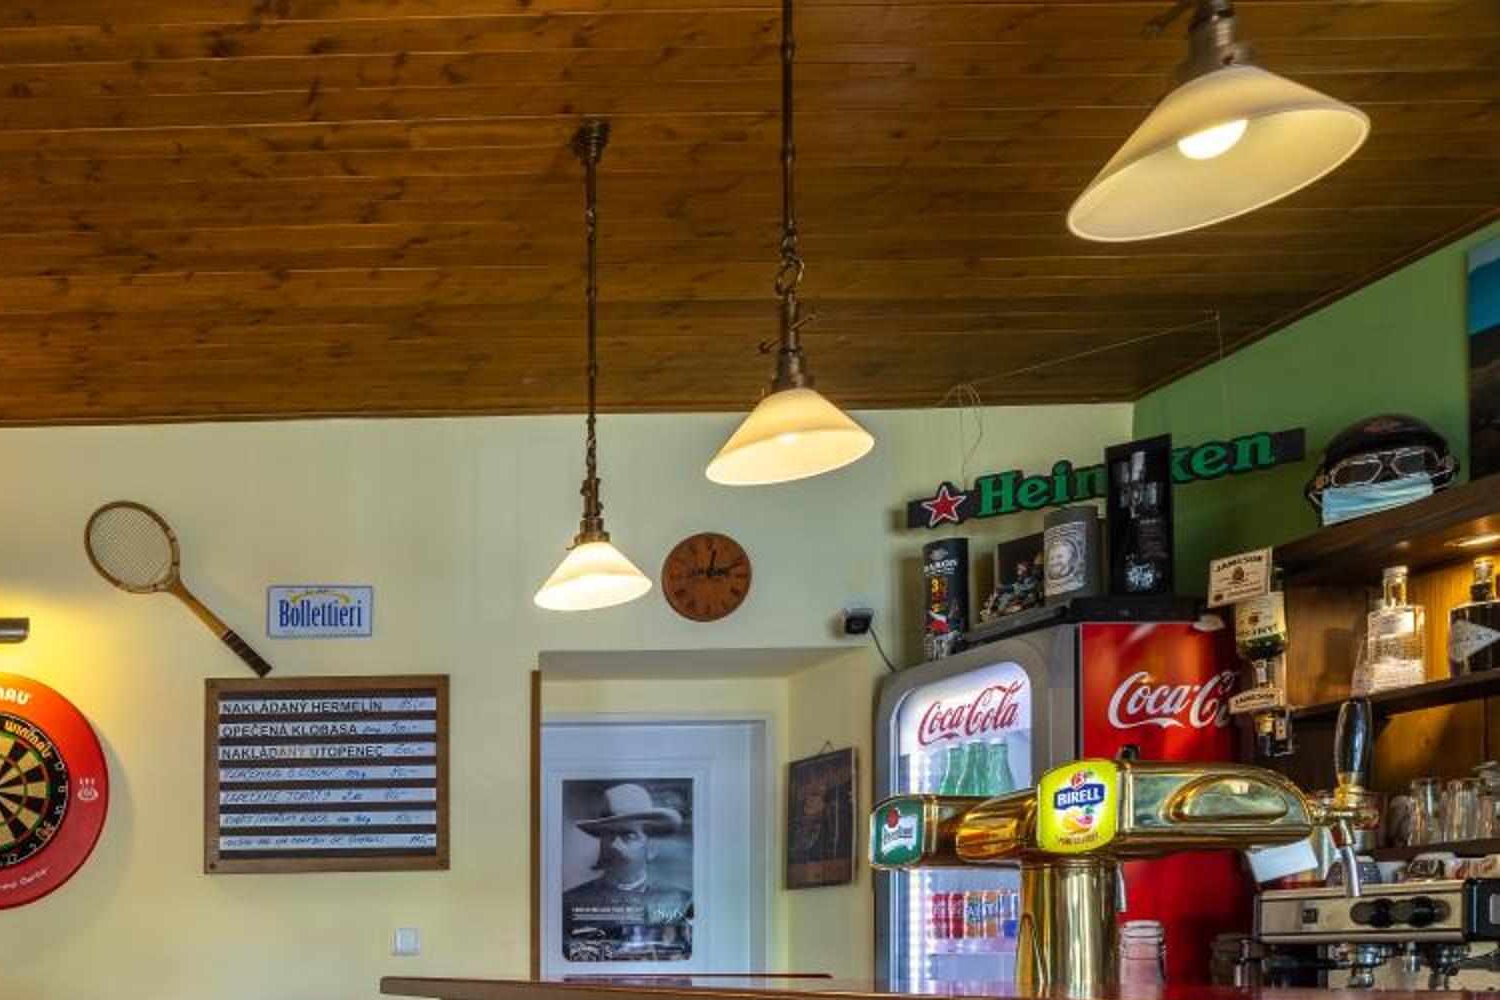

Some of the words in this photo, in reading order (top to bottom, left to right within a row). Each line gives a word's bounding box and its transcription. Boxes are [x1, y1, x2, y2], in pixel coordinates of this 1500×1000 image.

[977, 433, 1276, 517] Heinken
[279, 599, 362, 628] Bollettieri
[917, 678, 1025, 746] Coca-Cola
[1107, 670, 1235, 729] Coca-Co
[310, 744, 384, 758] UTOPENEC
[1056, 787, 1101, 807] BIRELL
